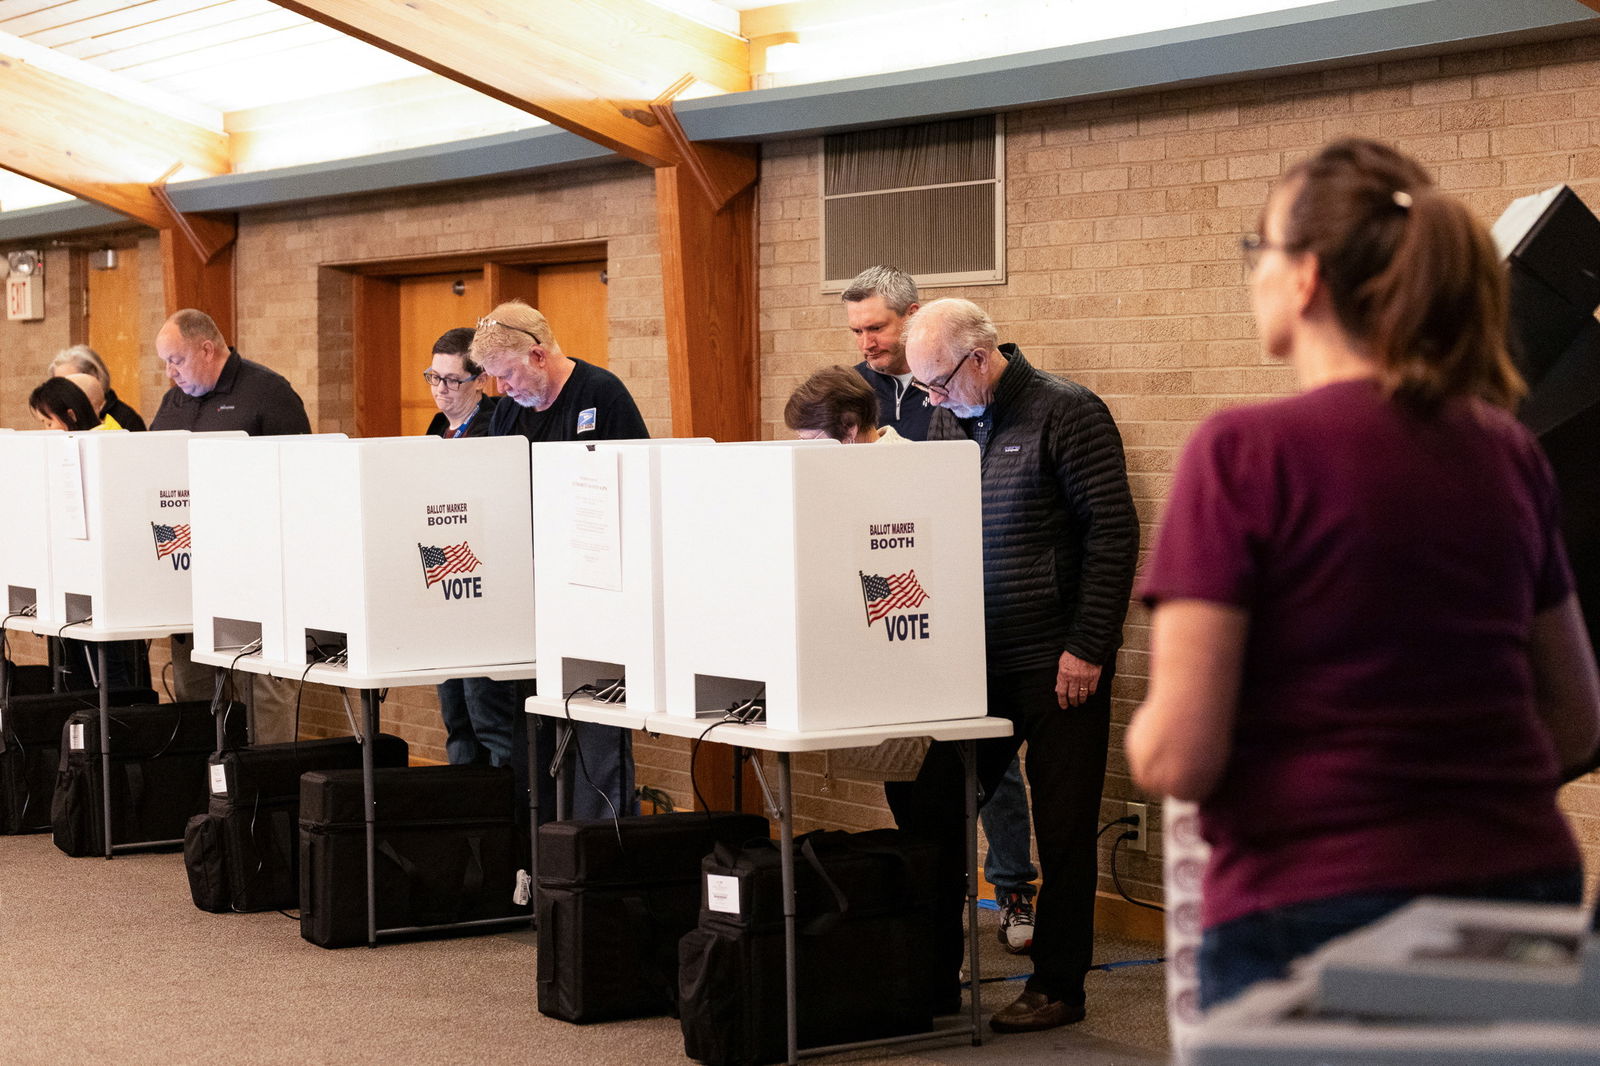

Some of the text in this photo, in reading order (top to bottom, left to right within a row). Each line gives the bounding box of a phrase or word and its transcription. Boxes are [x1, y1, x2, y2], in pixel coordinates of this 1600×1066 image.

[160, 489, 190, 498] BALLOT MARK
[160, 499, 190, 508] BOOT
[427, 503, 468, 514] BALLOT MARKER
[428, 514, 467, 526] BOOTH
[869, 522, 915, 536] BALLOT MARKER
[870, 537, 915, 550] BOOTH
[171, 552, 191, 571] VO
[442, 576, 482, 600] VOTE
[884, 613, 930, 642] VOTE
